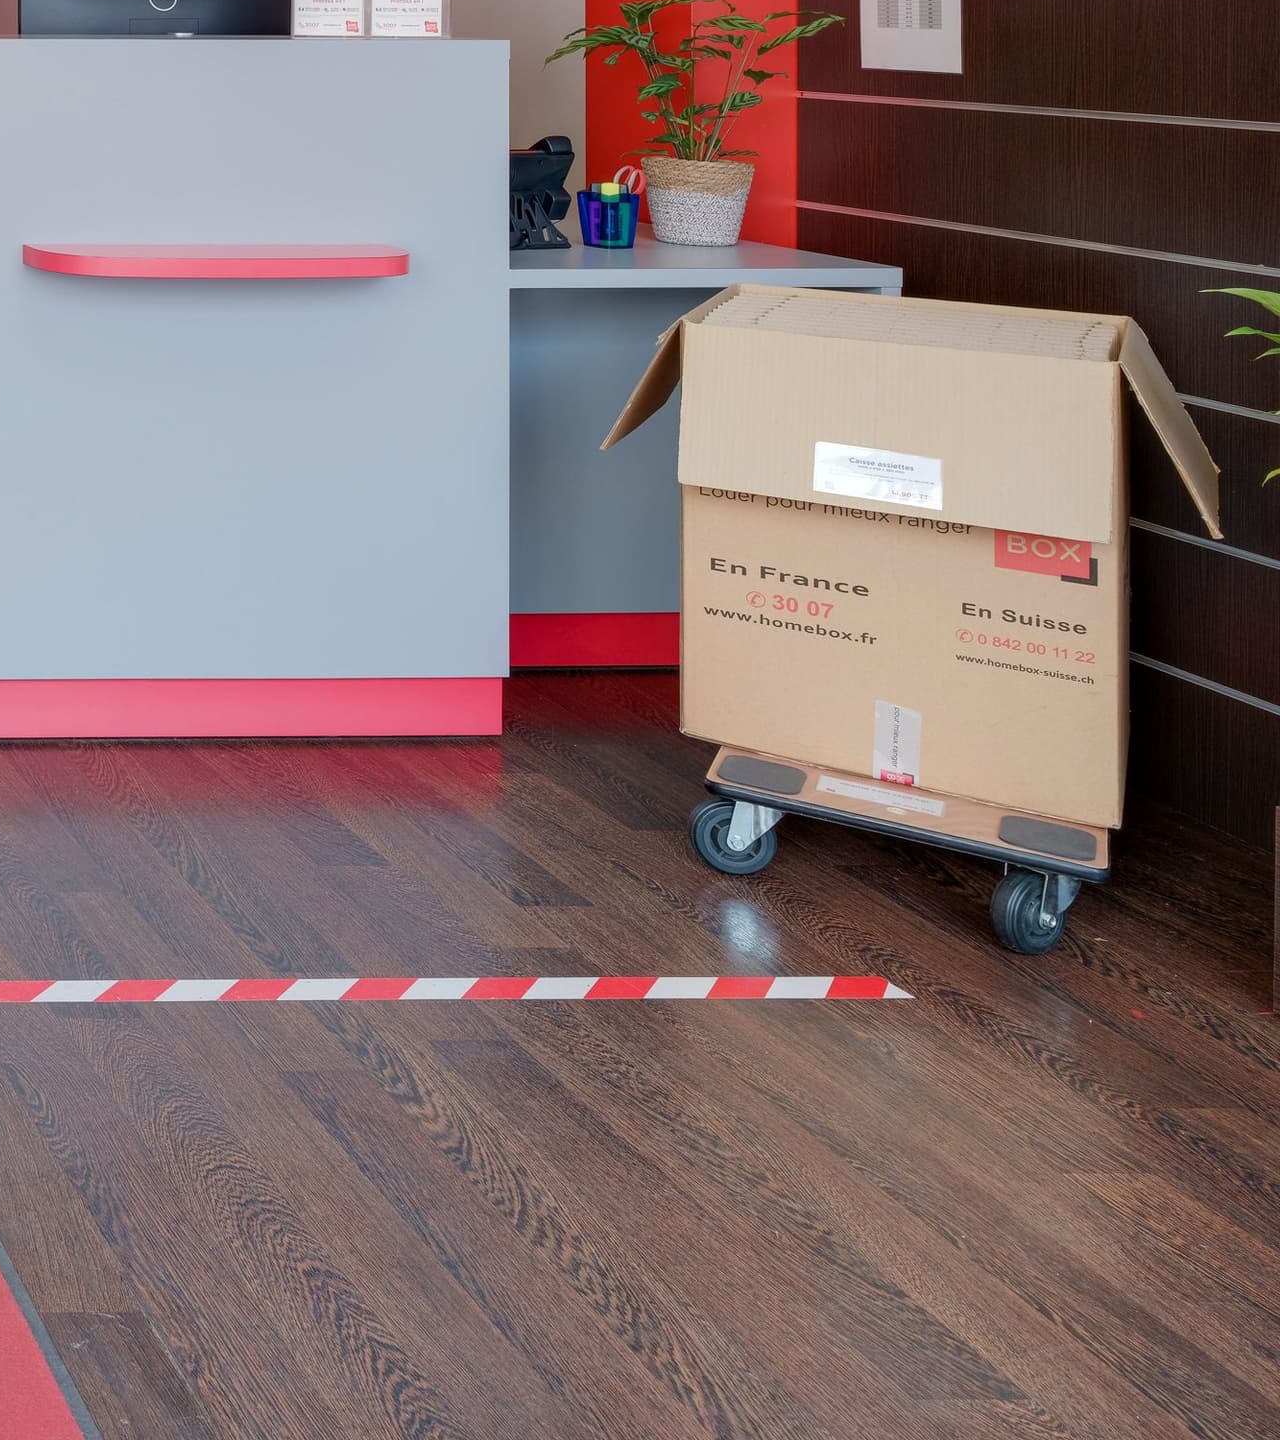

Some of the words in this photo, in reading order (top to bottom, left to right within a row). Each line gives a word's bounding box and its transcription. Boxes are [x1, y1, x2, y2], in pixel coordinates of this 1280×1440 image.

[848, 456, 876, 467] Caisse
[877, 461, 915, 472] assiettes
[698, 485, 757, 503] Louer
[766, 494, 816, 511] pour
[823, 503, 890, 524] mieux
[898, 514, 974, 536] ranger
[1007, 534, 1081, 563] BOX
[710, 557, 748, 577] En
[759, 565, 870, 597] France
[772, 594, 799, 613] 30
[807, 600, 835, 619] 07
[961, 602, 992, 620] En
[1001, 609, 1088, 636] Suisse
[703, 606, 878, 646] www.homebox.fr
[977, 633, 987, 645] 0
[992, 636, 1022, 651] 842
[1026, 642, 1046, 656] 00
[1052, 647, 1069, 660] 11
[1074, 650, 1096, 664] 22
[955, 653, 1095, 686] www.homebox-suisse.ch
